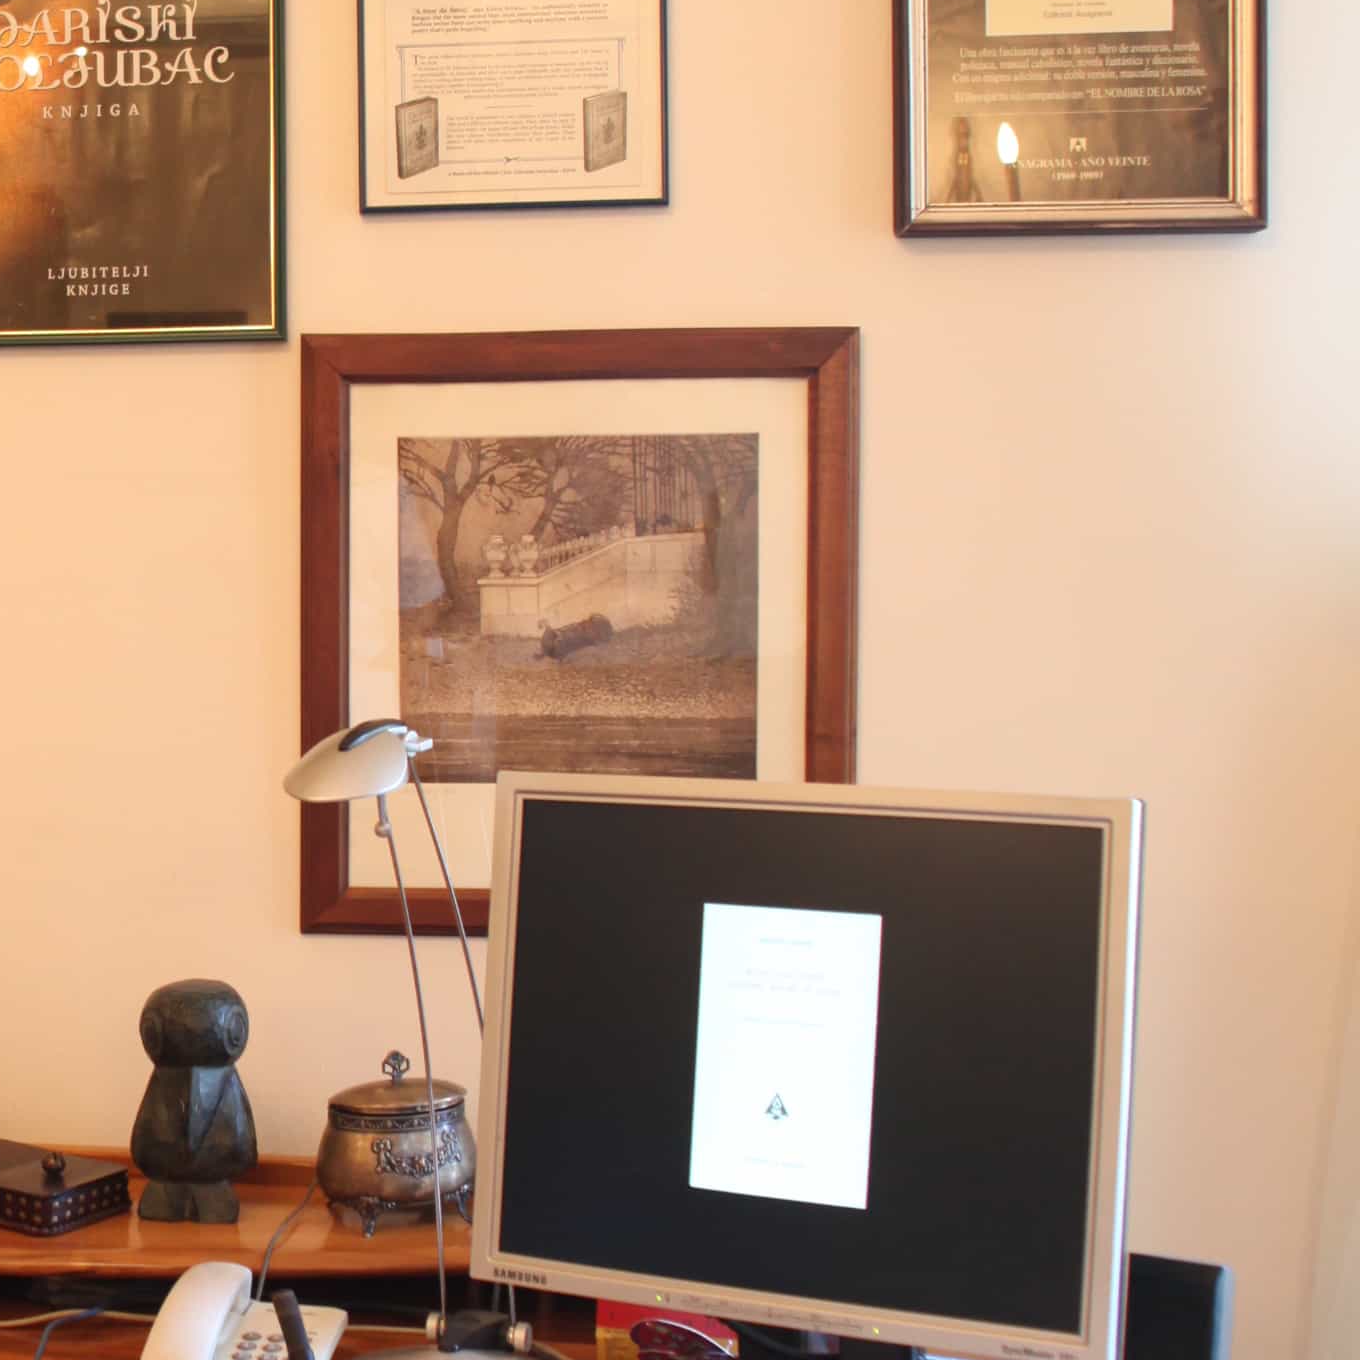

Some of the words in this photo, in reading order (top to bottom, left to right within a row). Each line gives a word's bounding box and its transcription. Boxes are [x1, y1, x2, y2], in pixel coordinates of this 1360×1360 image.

[42, 103, 141, 120] KNJIGA
[47, 264, 150, 281] LJUBITELJI
[65, 283, 131, 297] KNJIGE
[493, 1267, 549, 1286] SAMSUNG
